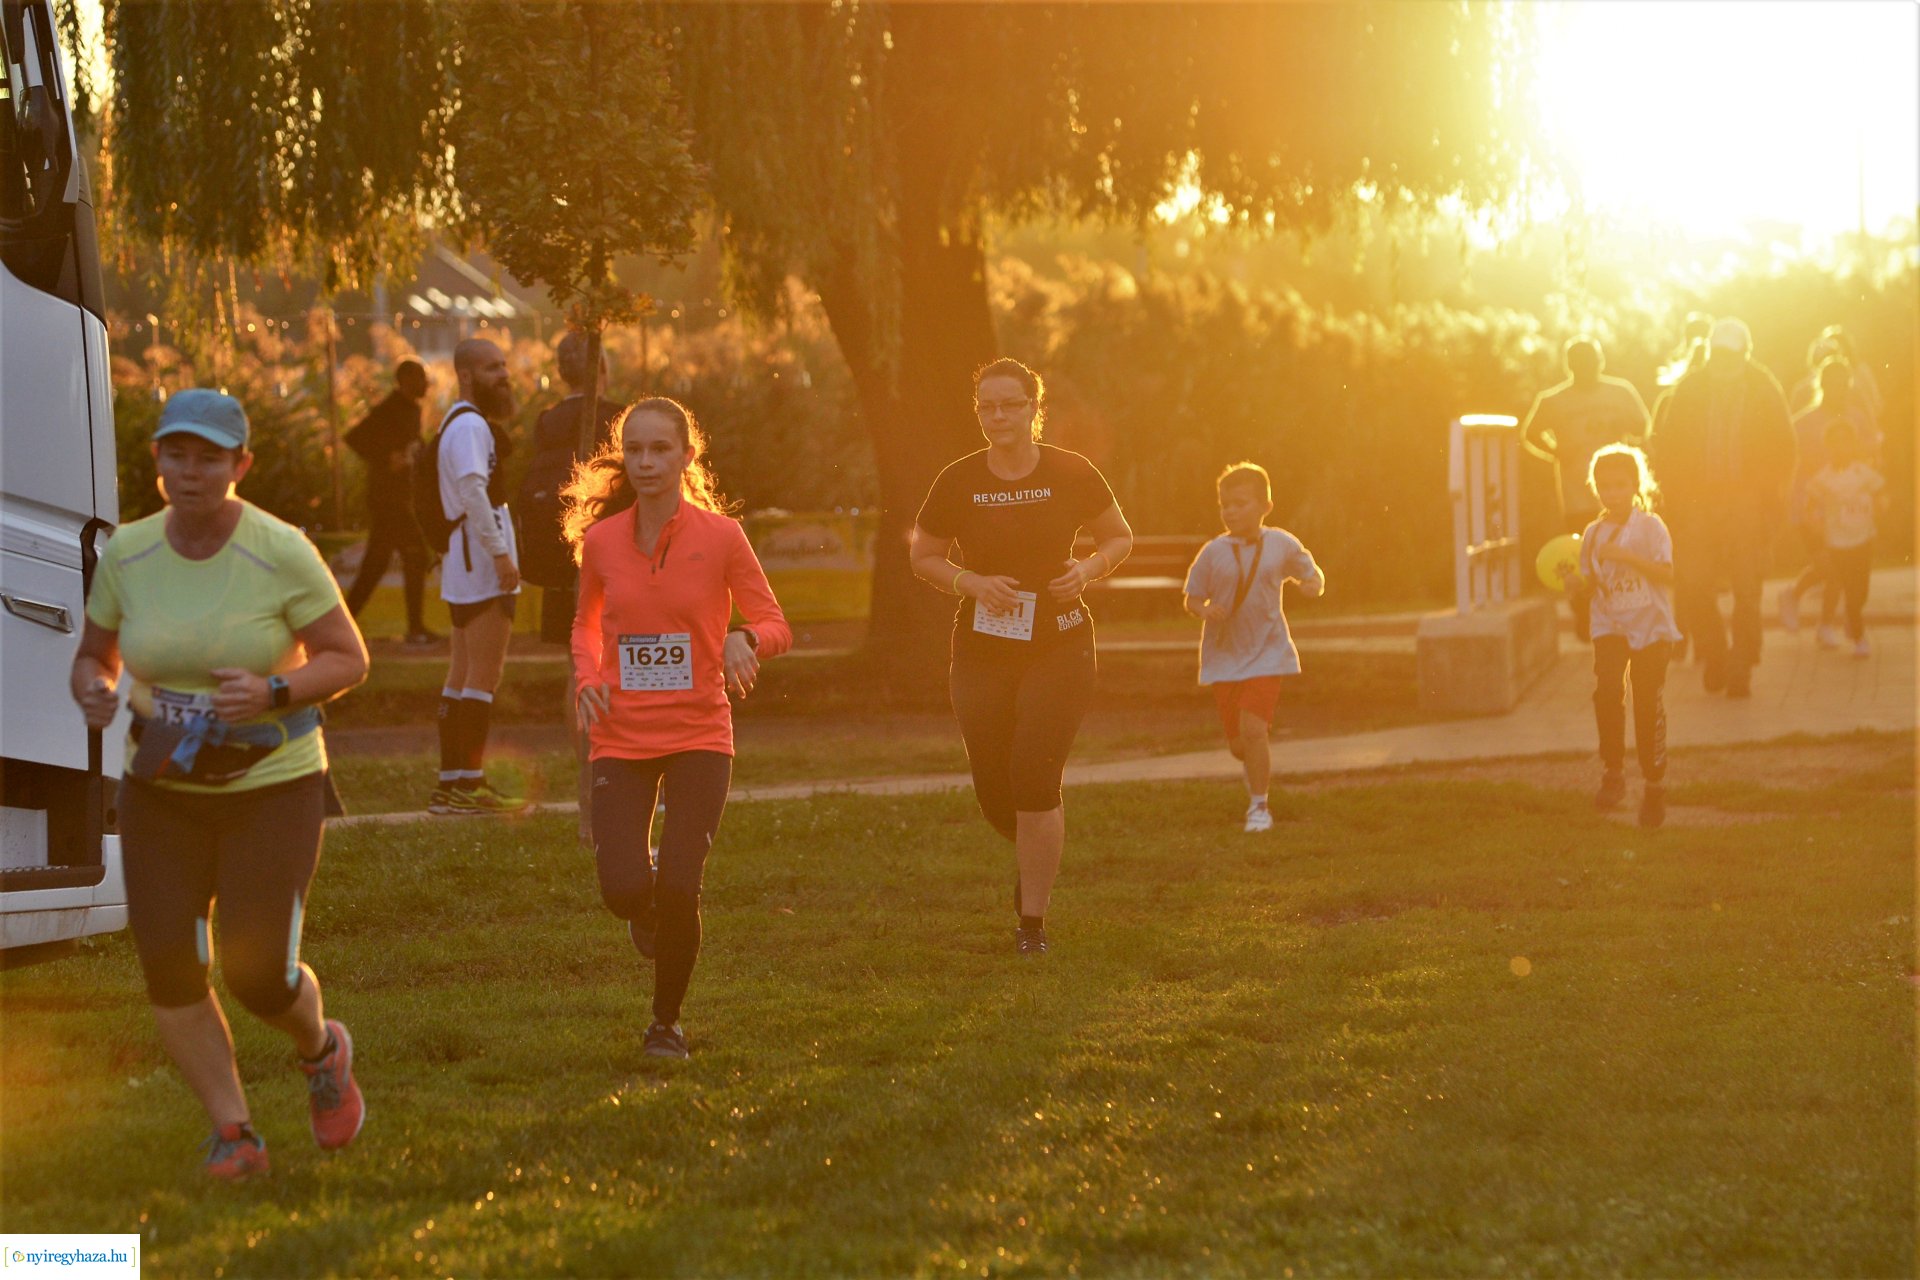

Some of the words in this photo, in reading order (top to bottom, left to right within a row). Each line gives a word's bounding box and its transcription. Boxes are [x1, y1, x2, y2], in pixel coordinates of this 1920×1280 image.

[973, 488, 1051, 503] REVOLUTION
[1058, 615, 1083, 631] EDITION
[625, 645, 685, 666] 1629
